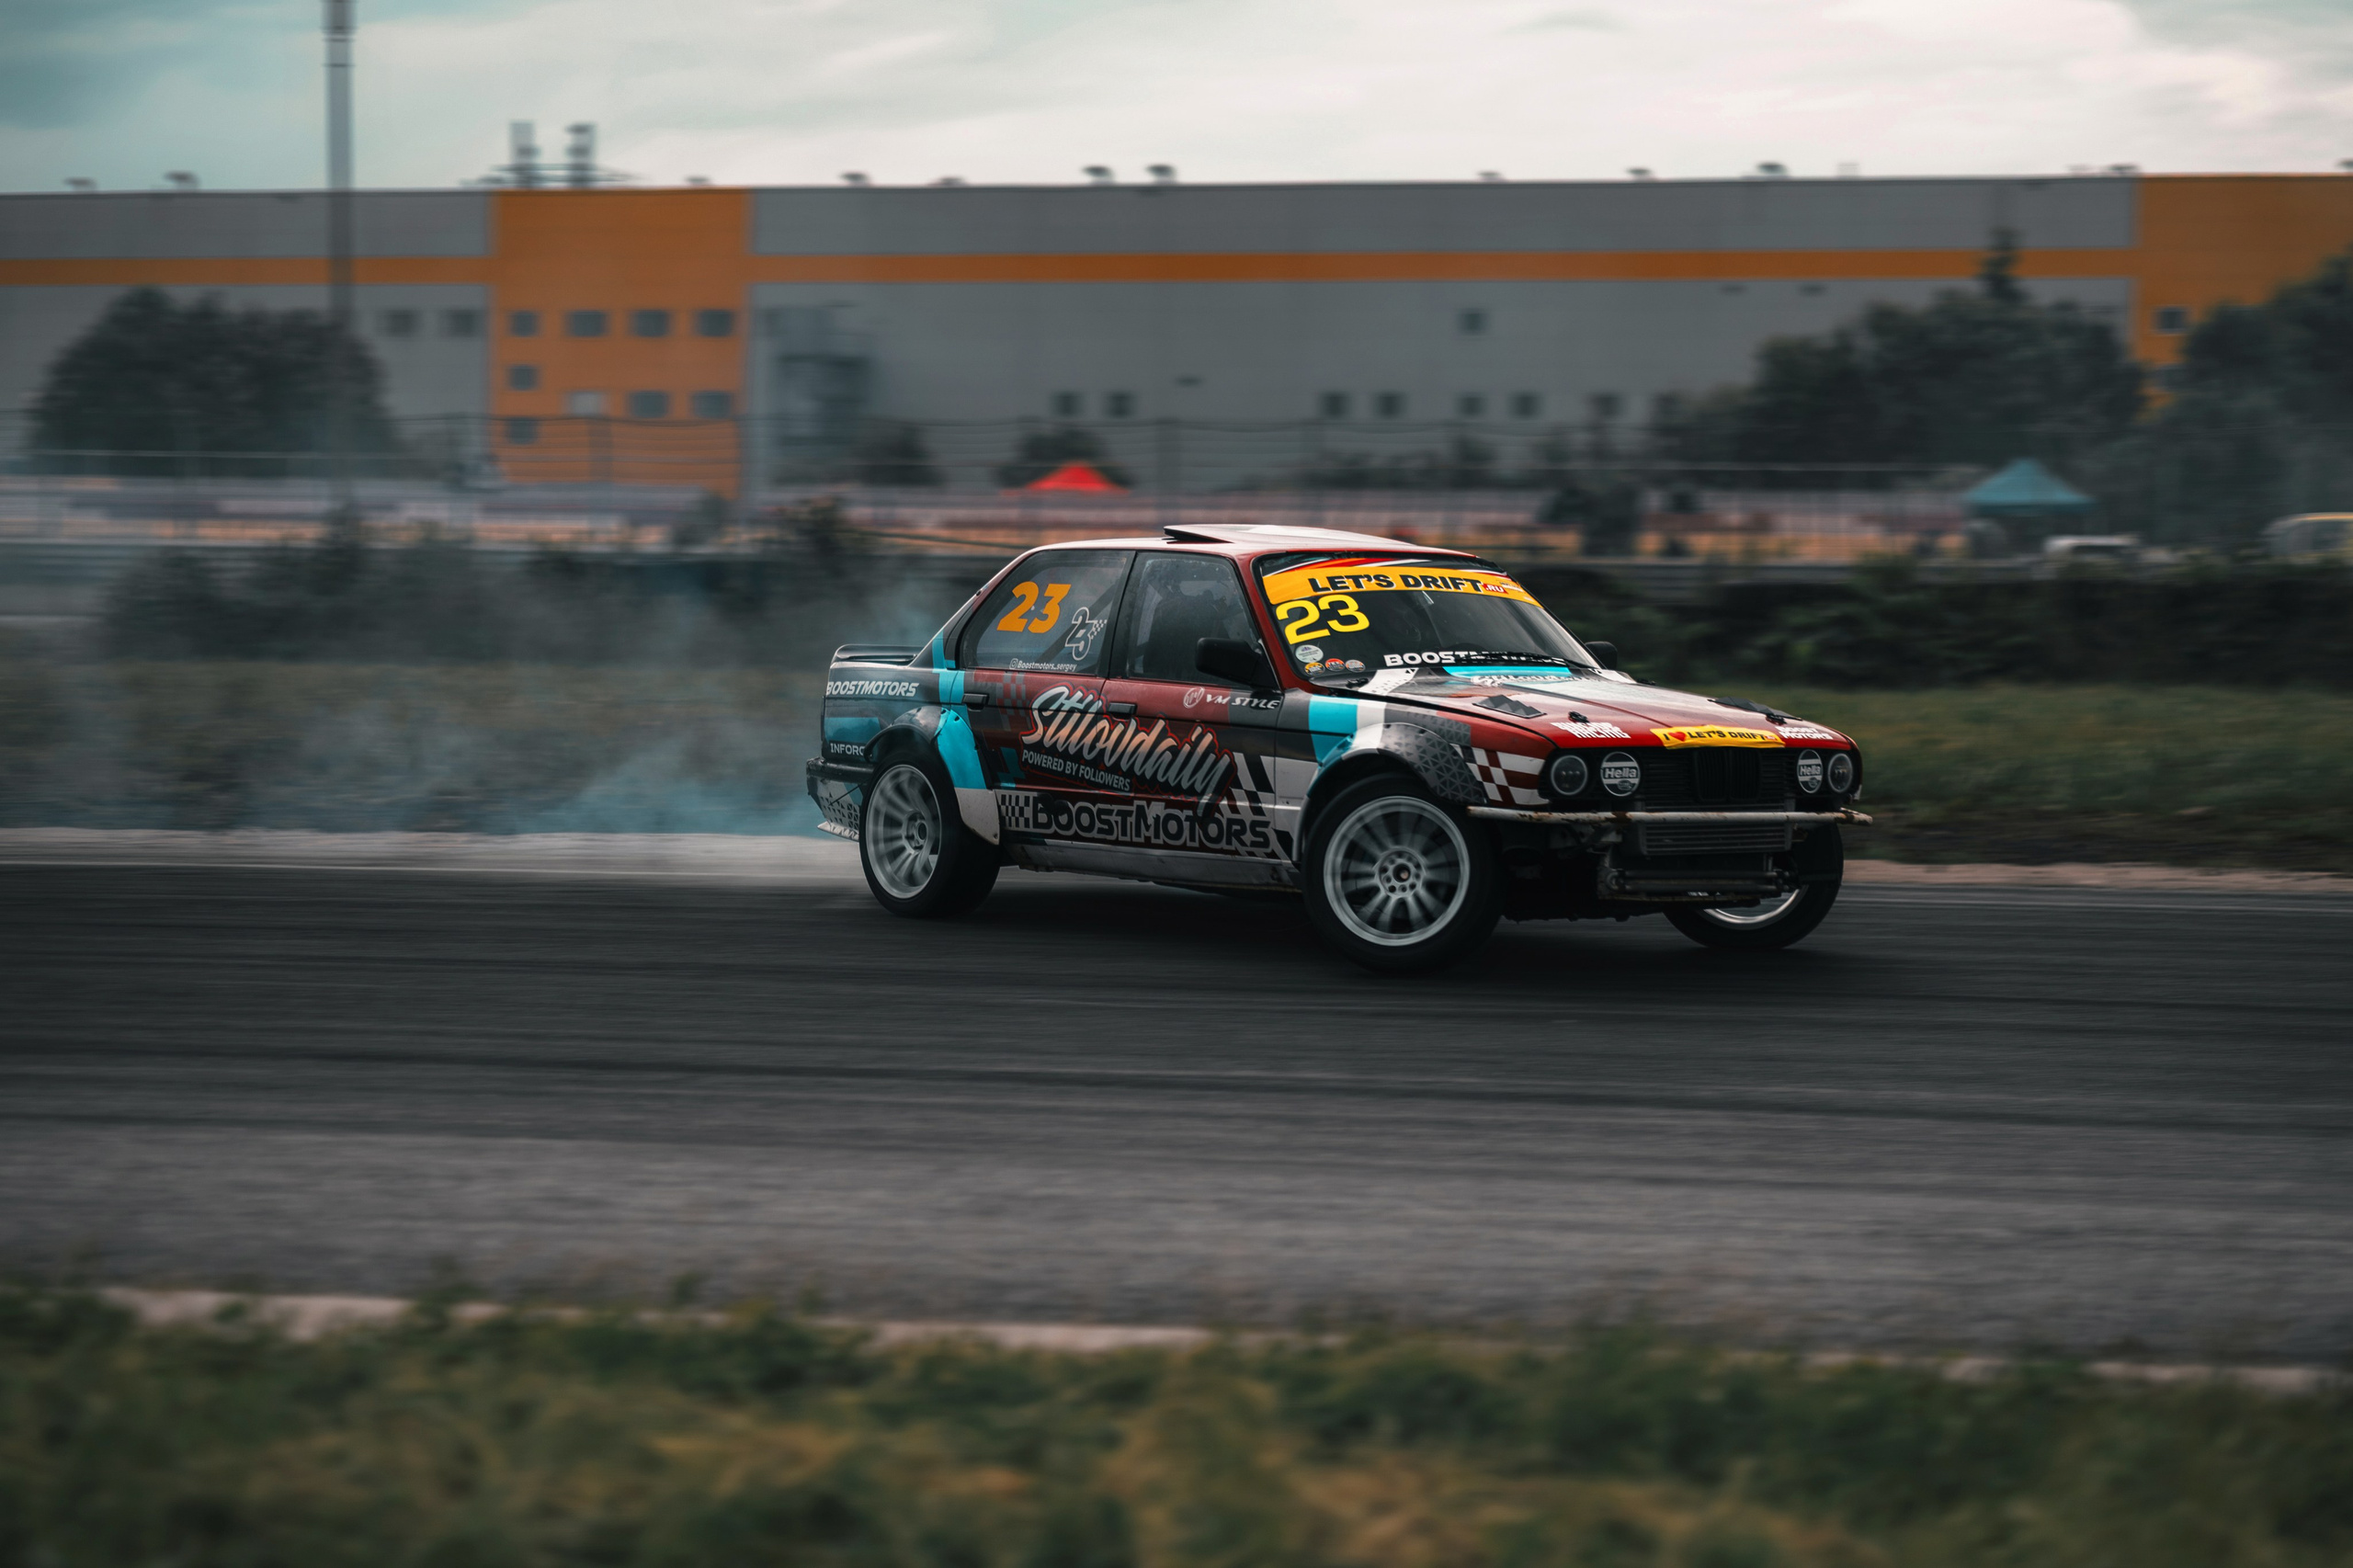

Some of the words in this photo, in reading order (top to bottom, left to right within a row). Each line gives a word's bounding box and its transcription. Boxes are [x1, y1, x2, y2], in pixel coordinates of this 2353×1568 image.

[1308, 574, 1397, 593] LET'S
[996, 581, 1072, 633] 23
[1276, 594, 1370, 644] 23
[826, 680, 919, 698] BOOSTMOTORS
[1232, 697, 1280, 710] STYLE
[1728, 731, 1767, 741] DRIFT
[1022, 748, 1063, 772] POWERED
[1064, 762, 1078, 778] BY
[1078, 765, 1131, 791] FOLLOWERS
[1605, 767, 1637, 778] Hella
[1800, 765, 1821, 776] Hella
